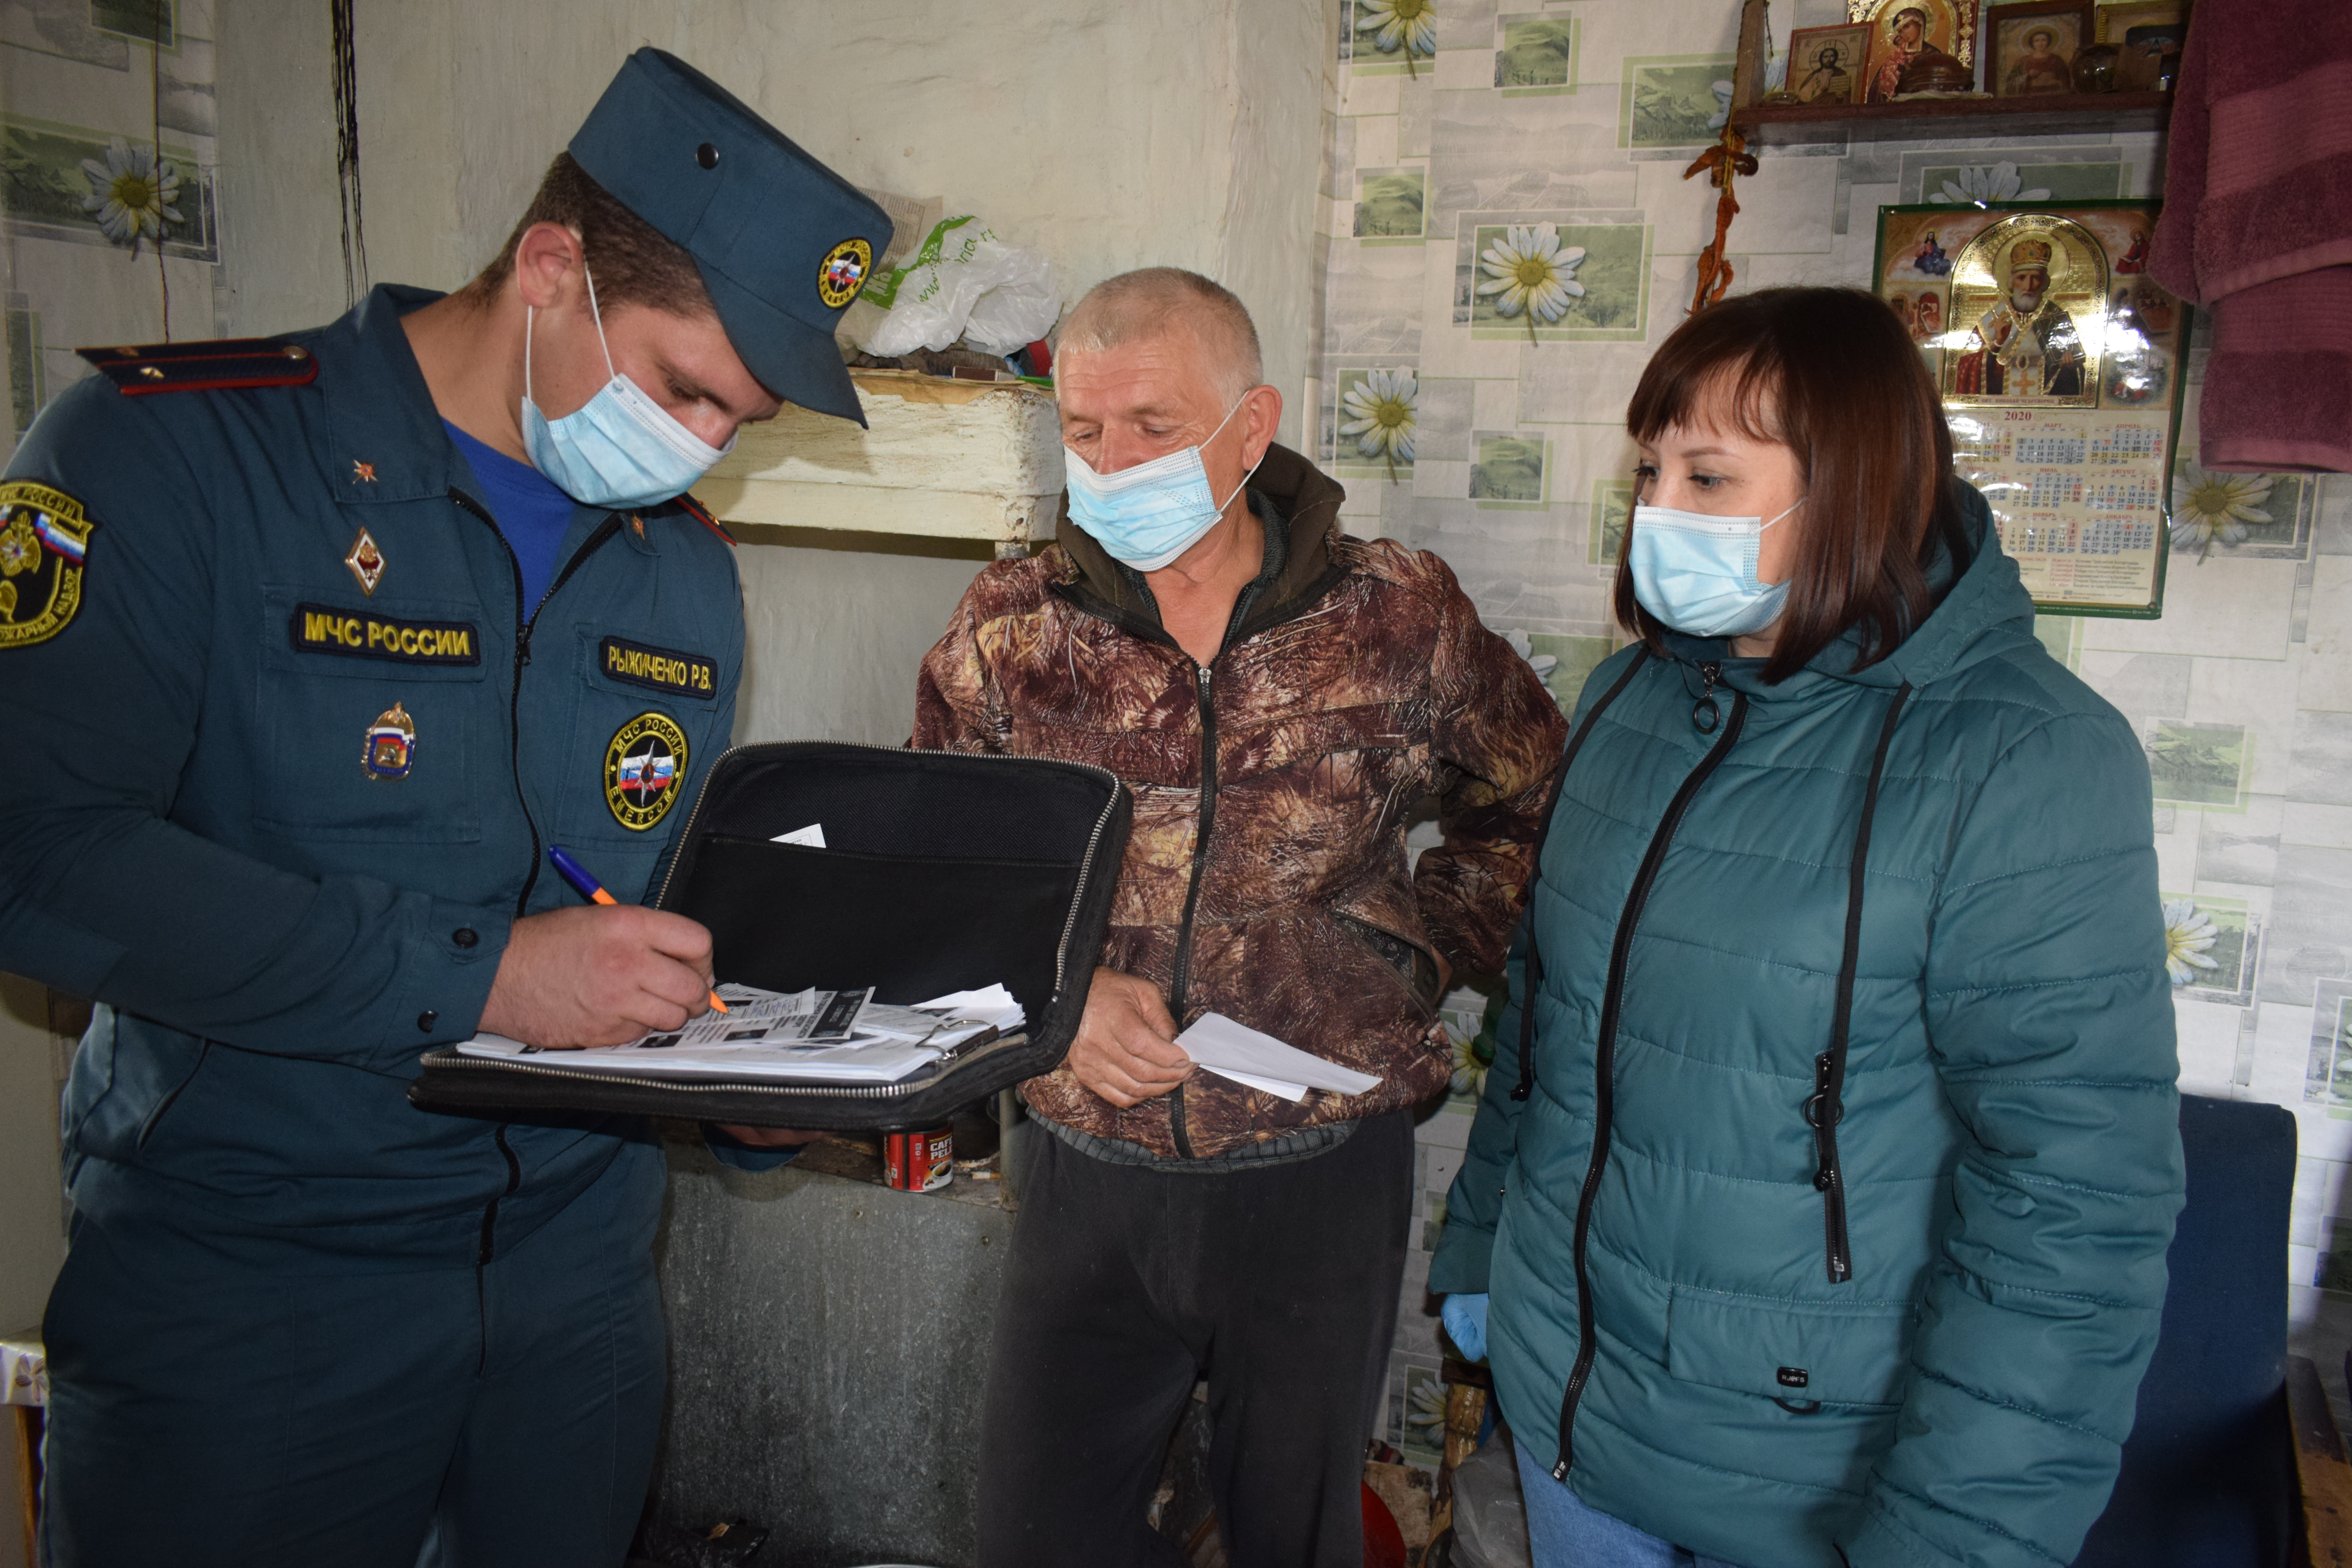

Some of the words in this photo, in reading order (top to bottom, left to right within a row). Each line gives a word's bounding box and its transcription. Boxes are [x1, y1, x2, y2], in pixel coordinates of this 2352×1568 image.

[2005, 412, 2032, 421] 2020
[22, 488, 75, 519] РОССИИ
[53, 568, 76, 615] НАДЗОР
[305, 612, 363, 647] МЧС
[368, 621, 471, 655] РОССИИ
[609, 646, 687, 686] РЫЖИЧЕНКО
[691, 664, 711, 690] Р.В.
[615, 724, 640, 753] МЧС
[645, 719, 683, 755] РОССИИ
[610, 786, 673, 824] EMERCOM
